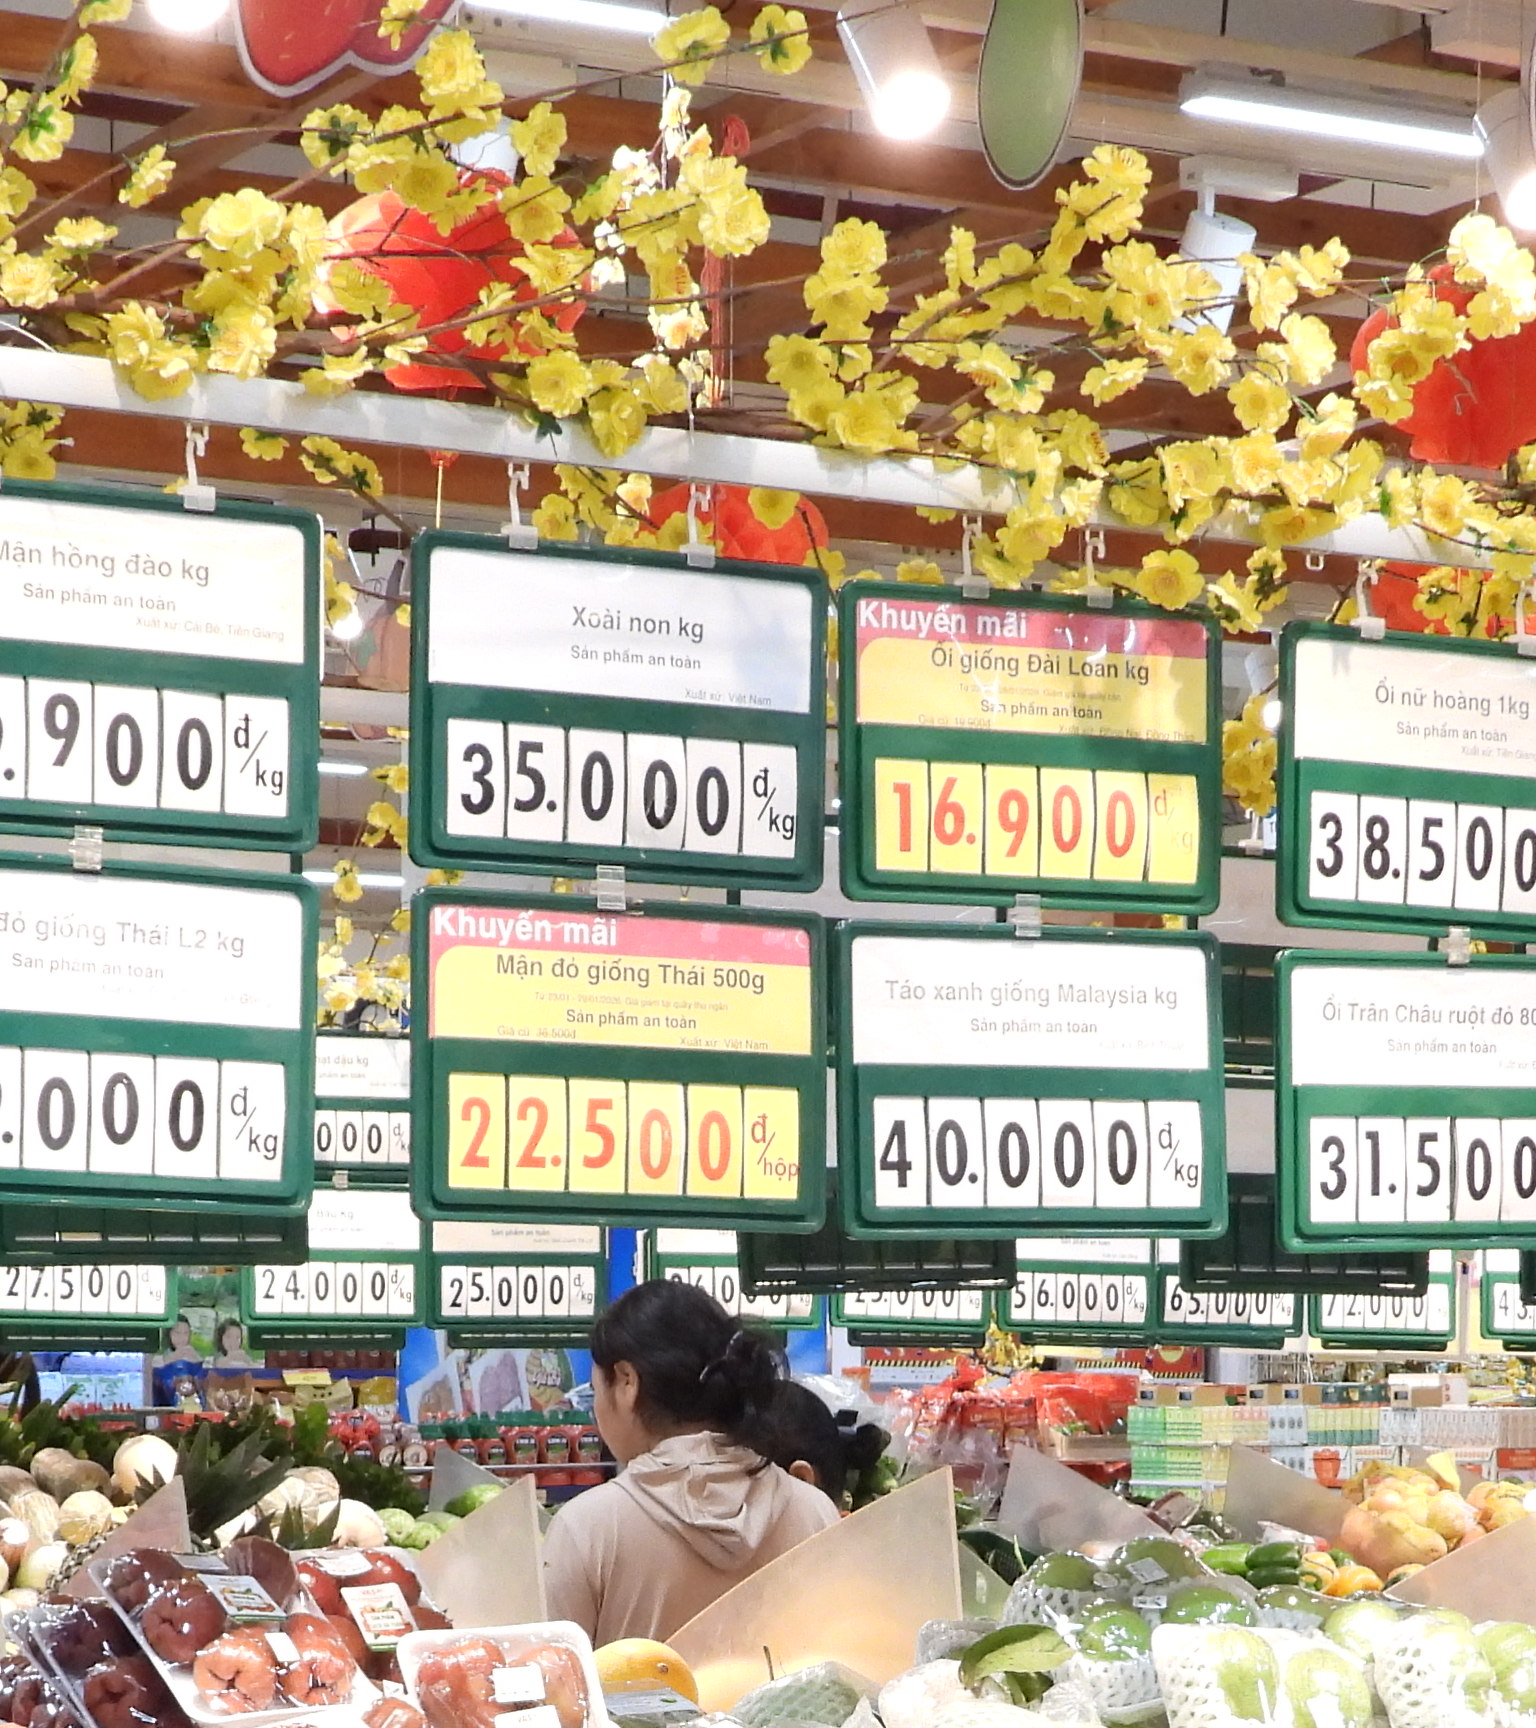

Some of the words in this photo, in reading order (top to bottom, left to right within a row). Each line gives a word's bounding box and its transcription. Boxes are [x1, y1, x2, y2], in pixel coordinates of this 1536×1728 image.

[52, 542, 115, 578] hồng
[125, 555, 172, 578] đào
[181, 559, 209, 586] kg
[113, 595, 134, 608] an
[140, 595, 176, 611] toàn
[860, 600, 966, 638] Khuyến
[977, 611, 1027, 638] mãi
[572, 606, 621, 630] Xoài
[630, 616, 670, 634] non
[679, 617, 703, 643] kg
[571, 645, 598, 662] Sản
[603, 648, 643, 666] phẩm
[649, 654, 665, 666] an
[670, 654, 701, 670] toàn
[960, 649, 1019, 676] giống
[1027, 653, 1061, 674] Đài
[1069, 661, 1118, 678] Loan
[1125, 661, 1150, 684] kg
[1375, 677, 1398, 705] Ổi
[1401, 687, 1427, 707] nữ
[1433, 690, 1491, 717] hoàng
[1500, 695, 1529, 719] 1kg
[1463, 729, 1477, 740] an
[460, 741, 729, 836] 35.000
[892, 777, 1135, 858] 16.900
[35, 912, 107, 947] giống
[118, 921, 169, 946] Thái
[179, 927, 207, 949] L2
[217, 930, 245, 958] kg
[434, 907, 552, 946] Khuyến
[564, 919, 617, 946] mãi
[497, 954, 543, 981] Mận
[551, 956, 579, 979] đỏ
[588, 958, 650, 988] giống
[658, 964, 705, 986] Thái
[713, 968, 765, 994] 500g
[885, 979, 925, 1000] Táo
[933, 982, 983, 1001] xanh
[990, 979, 1050, 1007] giống
[1058, 984, 1147, 1009] Malaysia
[1155, 988, 1177, 1009] kg
[1322, 994, 1340, 1021] Ổi
[1347, 1002, 1388, 1023] Trân
[1396, 1004, 1442, 1023] Châu
[1449, 1006, 1485, 1029] ruột
[1491, 1007, 1514, 1026] đỏ
[566, 1008, 595, 1024] Sản
[598, 1010, 639, 1028] phẩm
[643, 1015, 661, 1027] an
[665, 1013, 696, 1029] toàn
[1045, 1022, 1062, 1032] an
[460, 1096, 731, 1180] 22.500
[879, 1120, 1137, 1188] 40.000
[262, 1269, 385, 1301] 24.000
[449, 1271, 563, 1307] 25.000
[1014, 1281, 1118, 1309] 56.000
